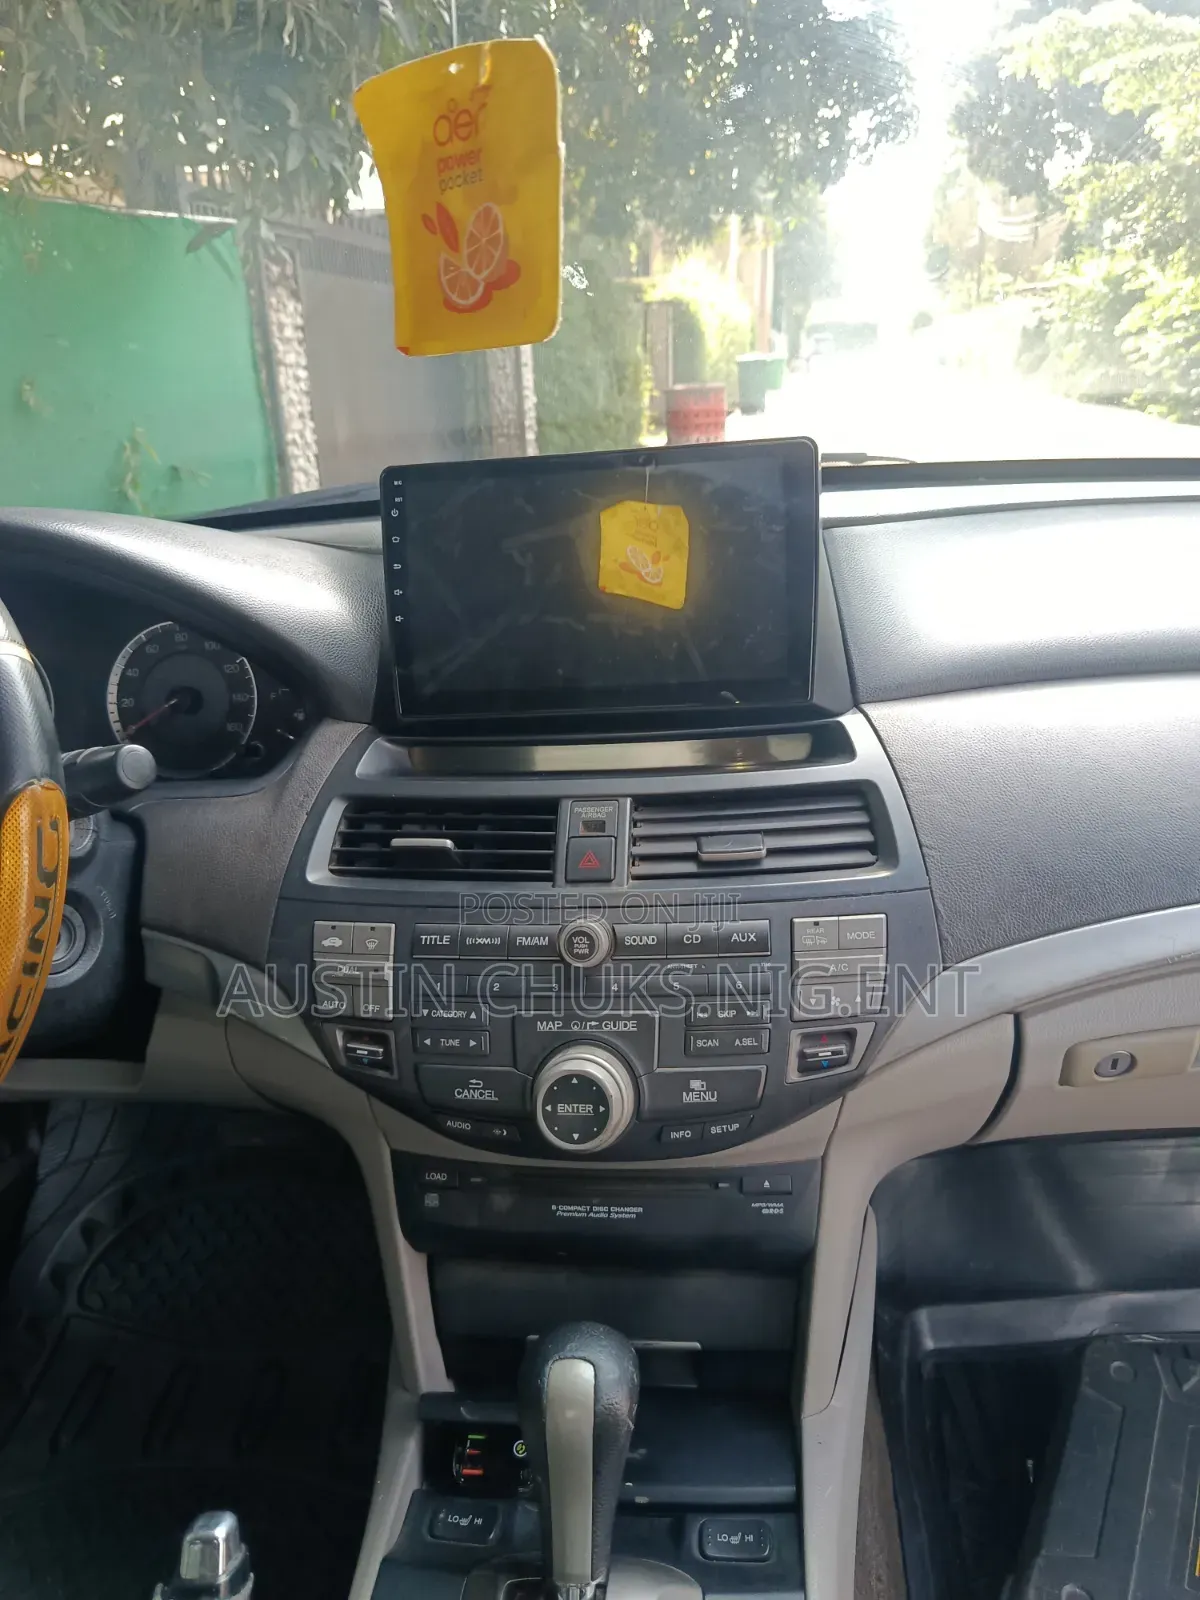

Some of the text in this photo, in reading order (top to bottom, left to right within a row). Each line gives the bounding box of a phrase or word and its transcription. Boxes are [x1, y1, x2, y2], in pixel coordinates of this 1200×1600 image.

[437, 148, 482, 177] power
[439, 168, 484, 195] pocket
[125, 668, 140, 677] 40
[121, 698, 134, 708] 20
[420, 935, 450, 946] TITLE
[572, 936, 590, 945] VOL
[624, 935, 657, 946] SOUND
[683, 934, 702, 944] CD
[730, 932, 757, 943] AUX
[846, 930, 876, 941] MODE
[516, 936, 549, 947] FM/AM
[337, 965, 360, 975] DUAL
[830, 963, 849, 973] A/C
[493, 982, 500, 992] 2
[552, 982, 559, 992] 3
[611, 982, 619, 992] 4
[673, 981, 680, 991] 5
[735, 980, 743, 990] 6
[322, 1000, 347, 1010] AUTO
[362, 1004, 381, 1014] OFF
[431, 1009, 467, 1019] CATEGORY
[717, 1009, 737, 1019] SKIP
[537, 1020, 638, 1031] MAP GUIDE
[440, 1038, 460, 1047] TUNE
[696, 1038, 719, 1048] SCAN
[454, 1088, 498, 1100] CANCEL
[682, 1090, 718, 1102] MENU
[556, 1103, 594, 1114] ENTER
[446, 1120, 471, 1130] AUDIO
[710, 1123, 740, 1134] SETUP
[670, 1129, 692, 1139] INFO
[425, 1172, 448, 1182] LOAD
[448, 1515, 483, 1525] LO HI
[717, 1533, 754, 1543] LO HI
